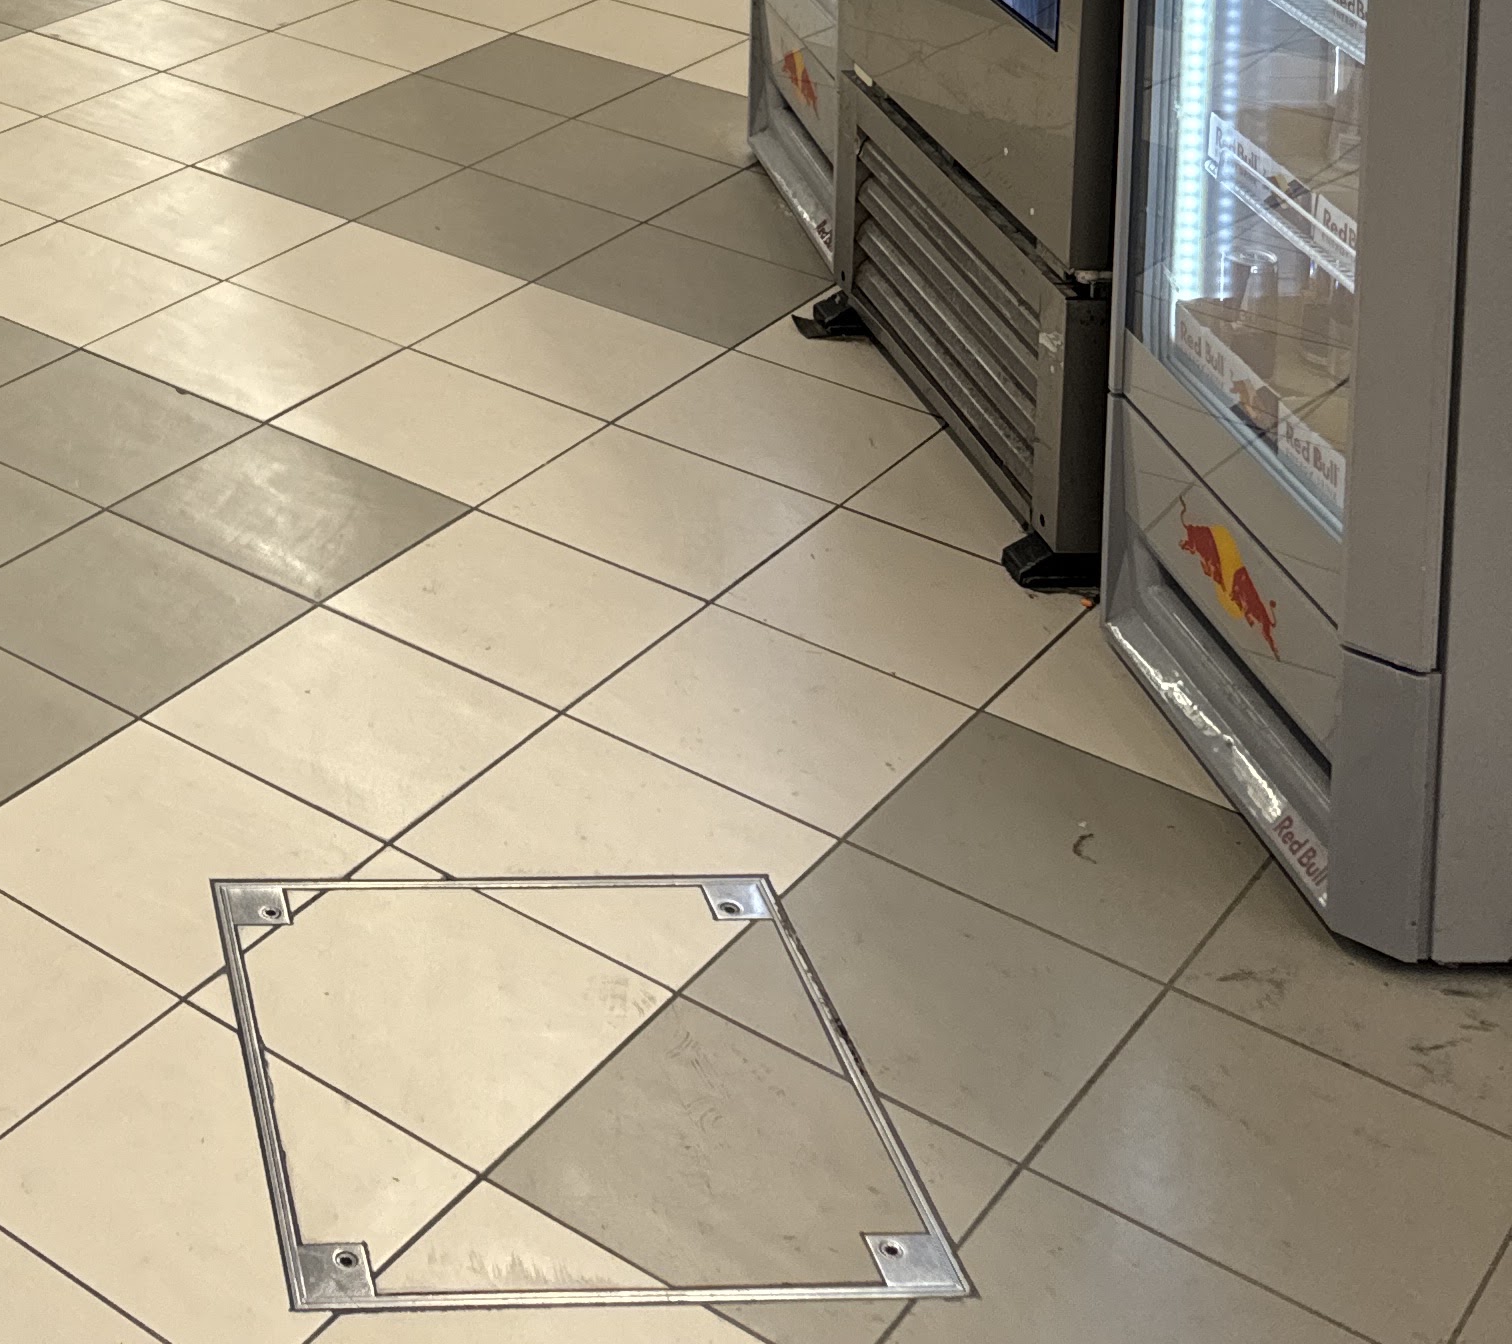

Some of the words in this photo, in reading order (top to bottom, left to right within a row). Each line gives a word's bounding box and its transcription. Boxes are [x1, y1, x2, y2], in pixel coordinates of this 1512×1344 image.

[1180, 320, 1202, 358] Red
[1204, 339, 1225, 378] Bull
[1285, 420, 1311, 464] Red
[1312, 442, 1339, 489] Bull
[1272, 815, 1310, 856] Red
[1296, 846, 1328, 887] Bull
